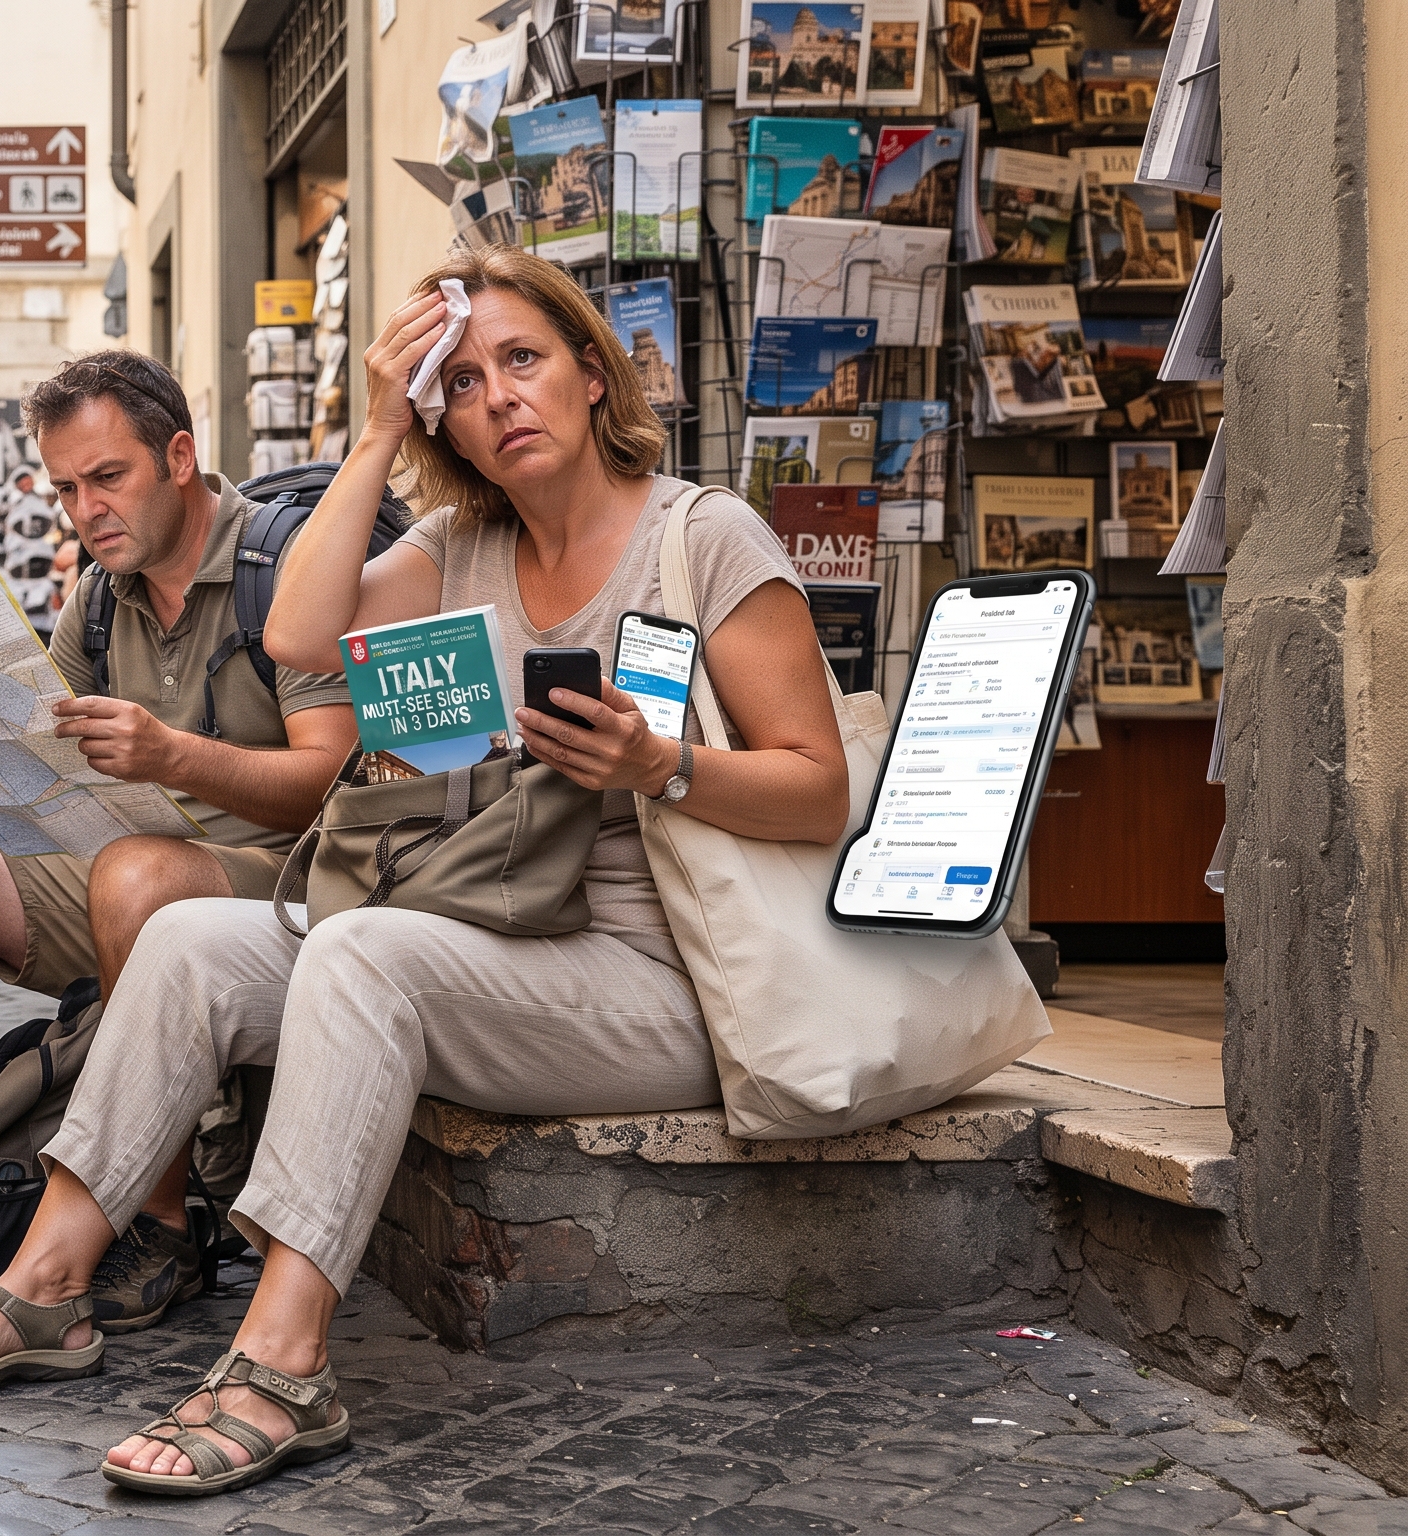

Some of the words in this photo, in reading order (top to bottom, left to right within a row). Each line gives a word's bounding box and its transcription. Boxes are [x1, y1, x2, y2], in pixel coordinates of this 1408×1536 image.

[377, 652, 457, 697] ITALY
[362, 693, 434, 720] MUST-SEE
[436, 683, 491, 708] SIGHTS
[390, 716, 408, 735] IN
[411, 714, 422, 731] 3
[426, 706, 472, 729] DAYS
